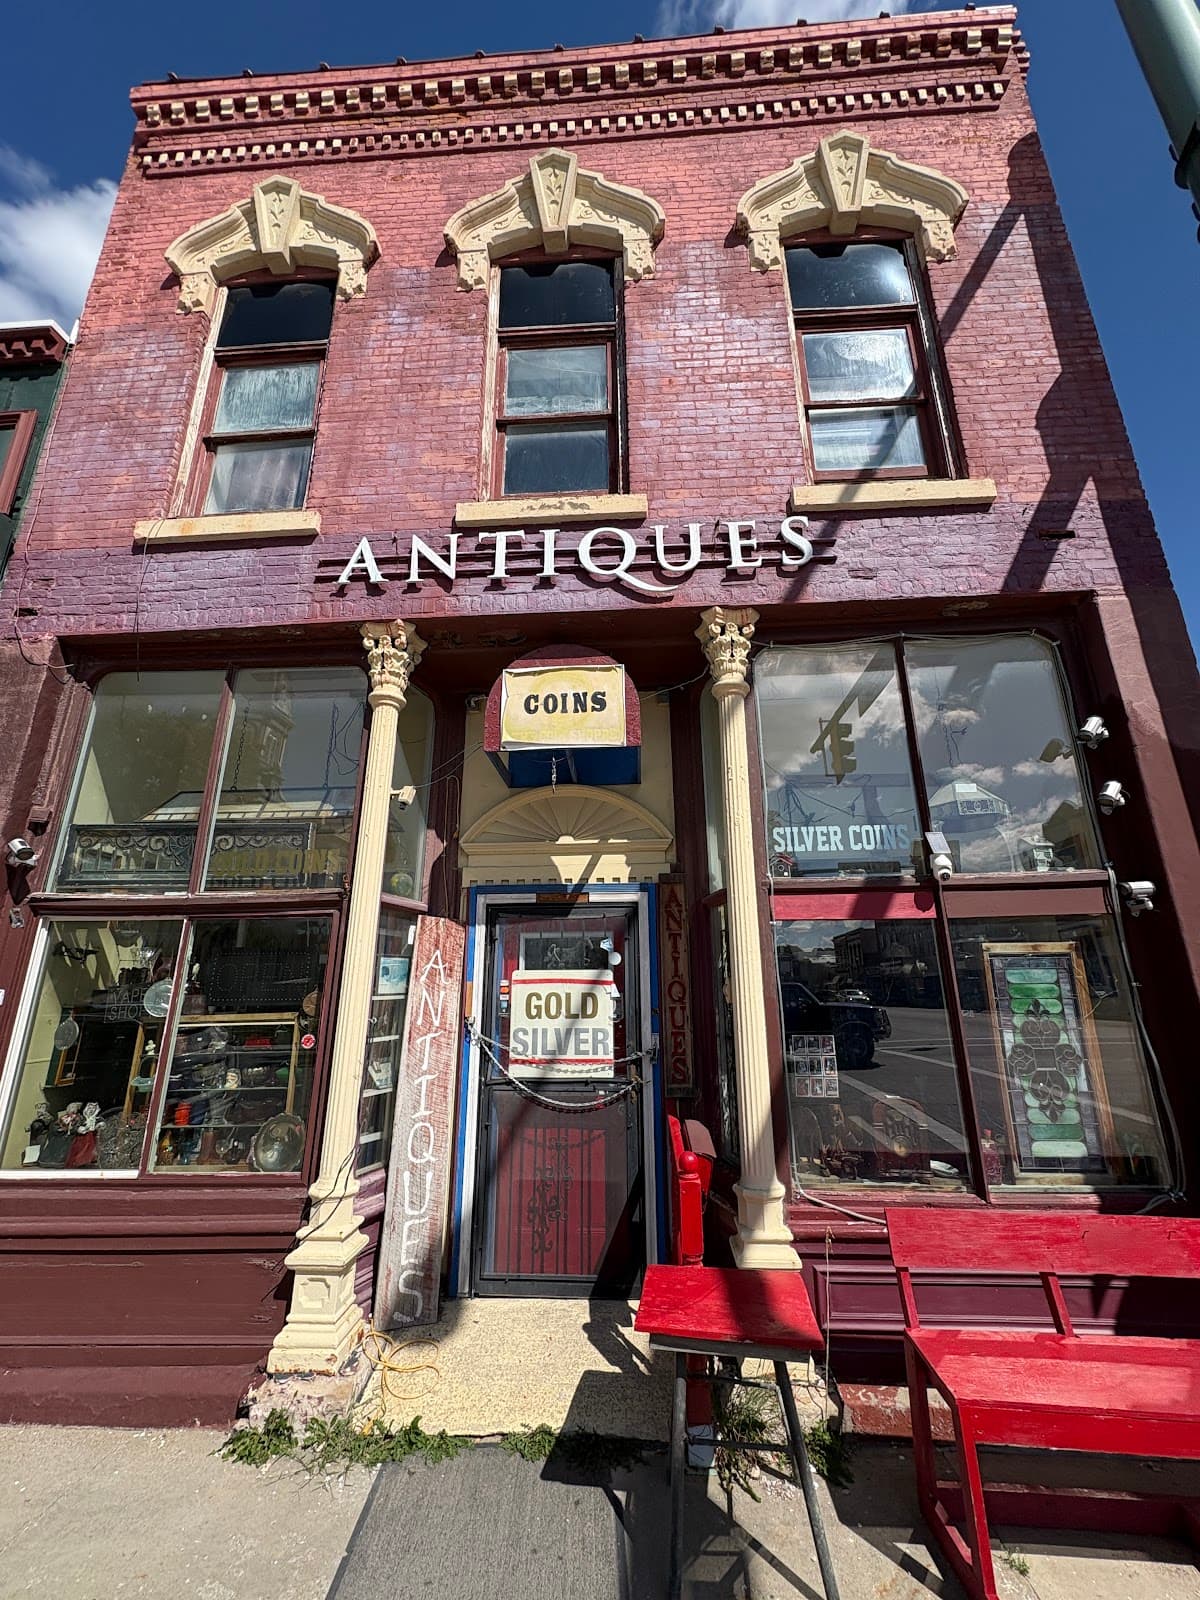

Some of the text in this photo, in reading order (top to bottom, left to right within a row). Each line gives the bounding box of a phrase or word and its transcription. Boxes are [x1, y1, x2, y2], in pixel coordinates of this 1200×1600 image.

[337, 516, 813, 592] ANTIQUES
[524, 691, 607, 714] COINS
[773, 825, 911, 852] SILVER COINS
[665, 888, 687, 1085] ANTIQUES
[525, 992, 598, 1019] GOLD
[512, 1027, 610, 1057] SILVER
[394, 949, 450, 1323] ANTIQUES
